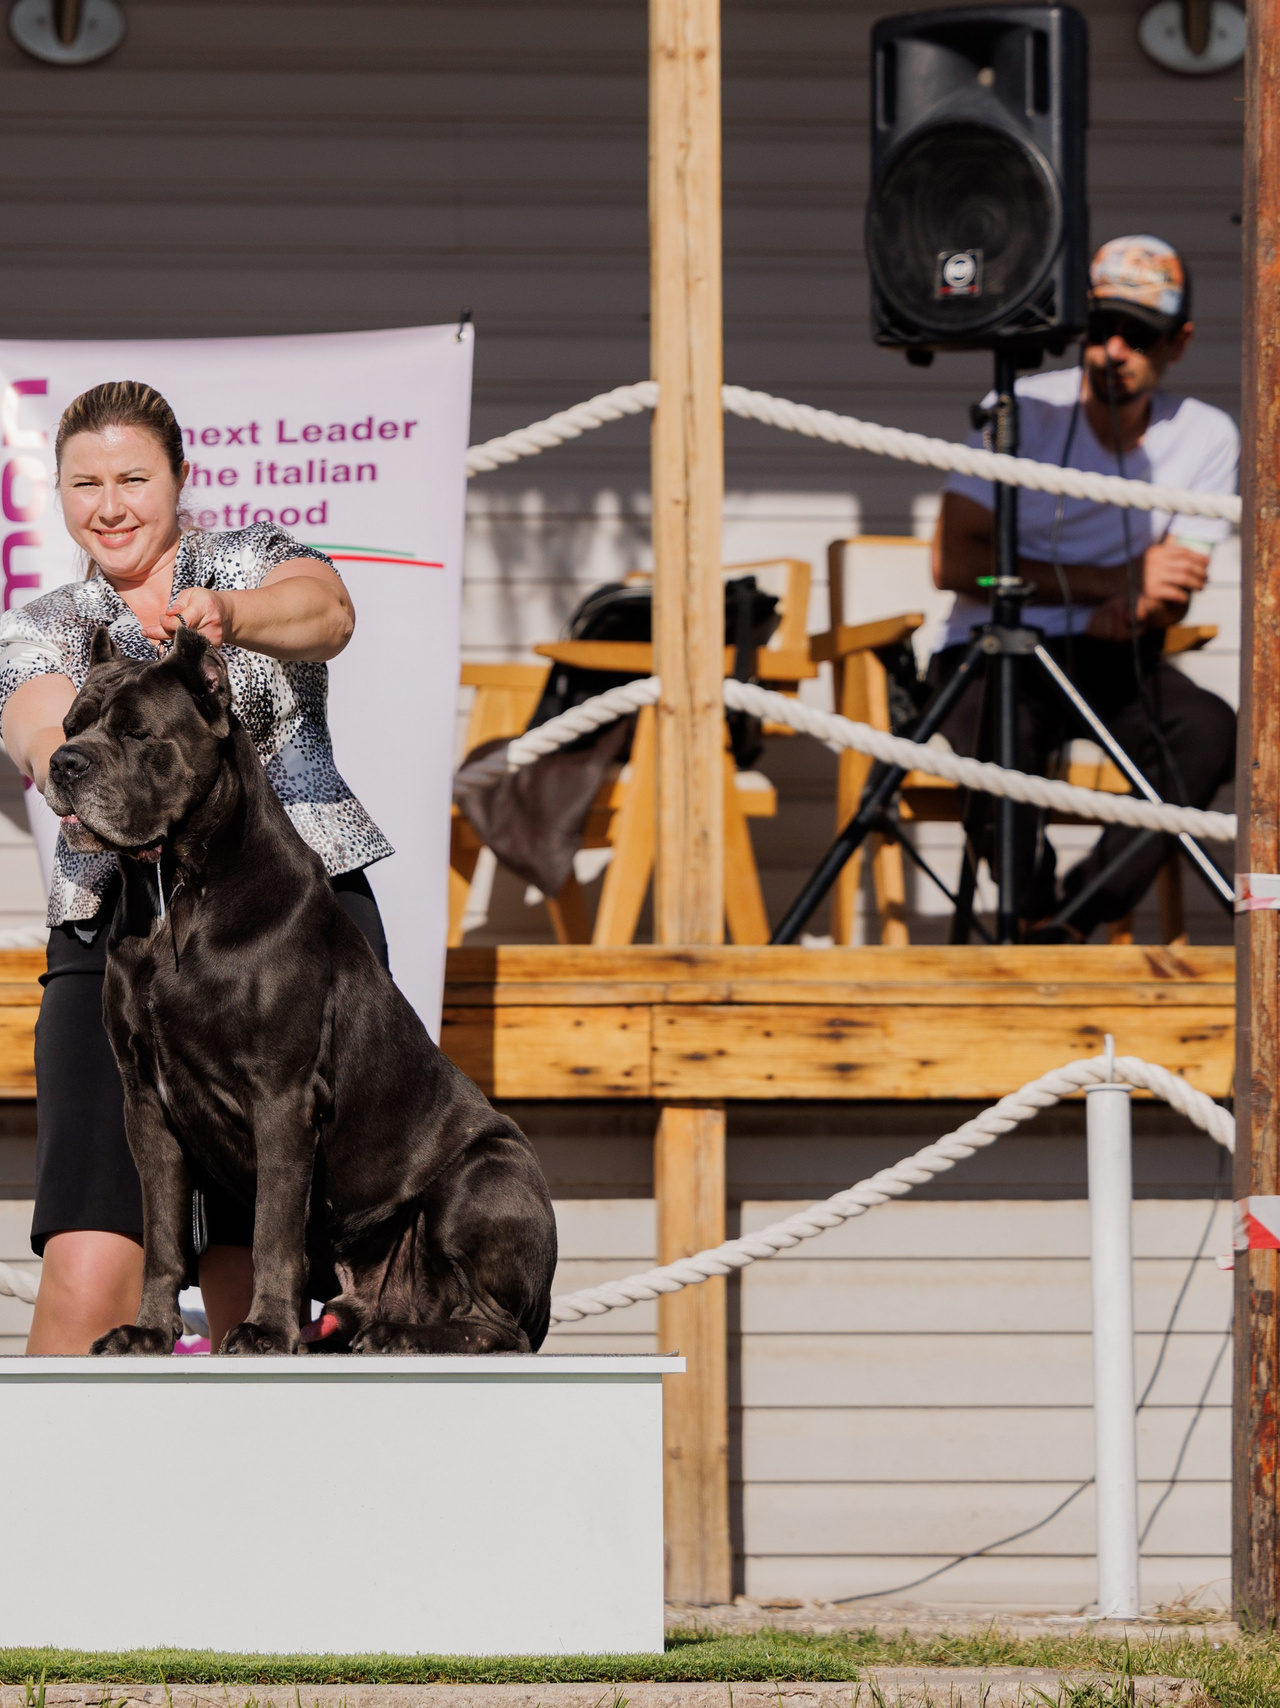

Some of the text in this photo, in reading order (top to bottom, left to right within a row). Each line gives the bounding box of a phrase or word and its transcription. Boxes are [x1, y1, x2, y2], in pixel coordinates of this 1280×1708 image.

[278, 417, 418, 444] Leader
[192, 459, 378, 487] he italian
[2, 379, 48, 612] mon
